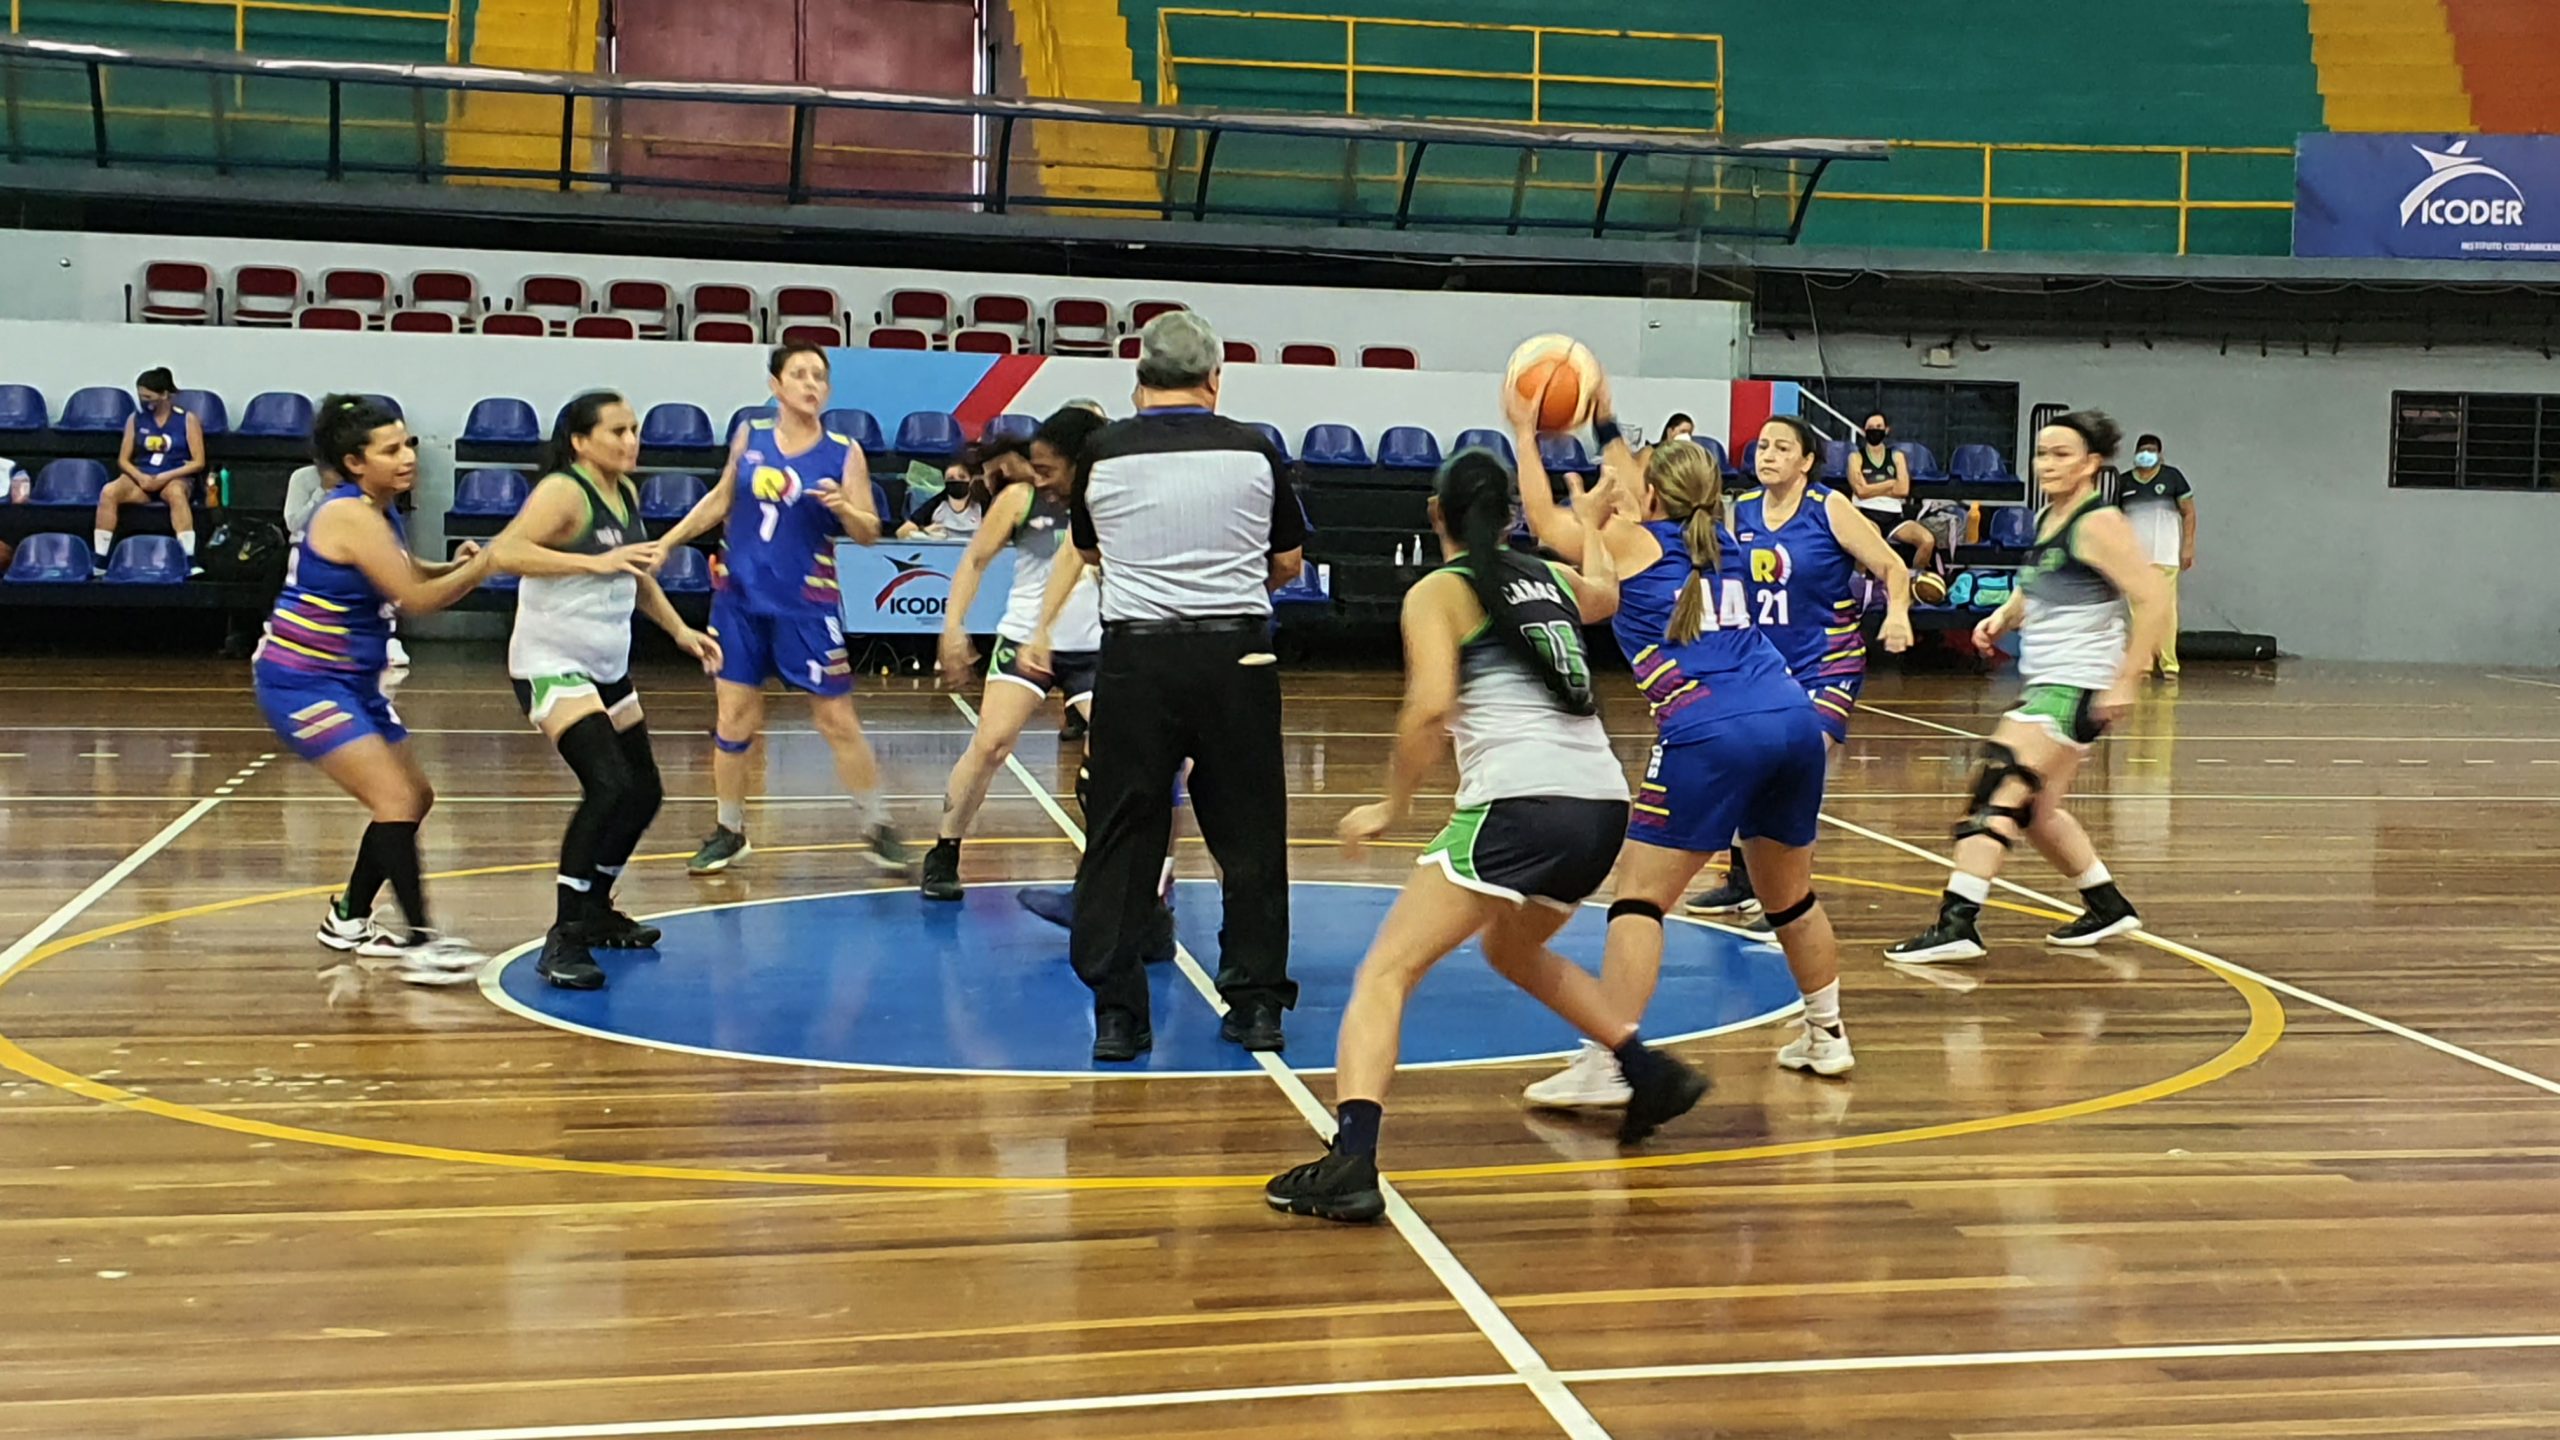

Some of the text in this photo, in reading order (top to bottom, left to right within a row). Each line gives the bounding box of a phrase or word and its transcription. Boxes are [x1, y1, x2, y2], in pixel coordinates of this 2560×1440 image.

[2421, 199, 2523, 225] ICODER
[760, 502, 779, 542] 7
[1757, 588, 1789, 625] 21
